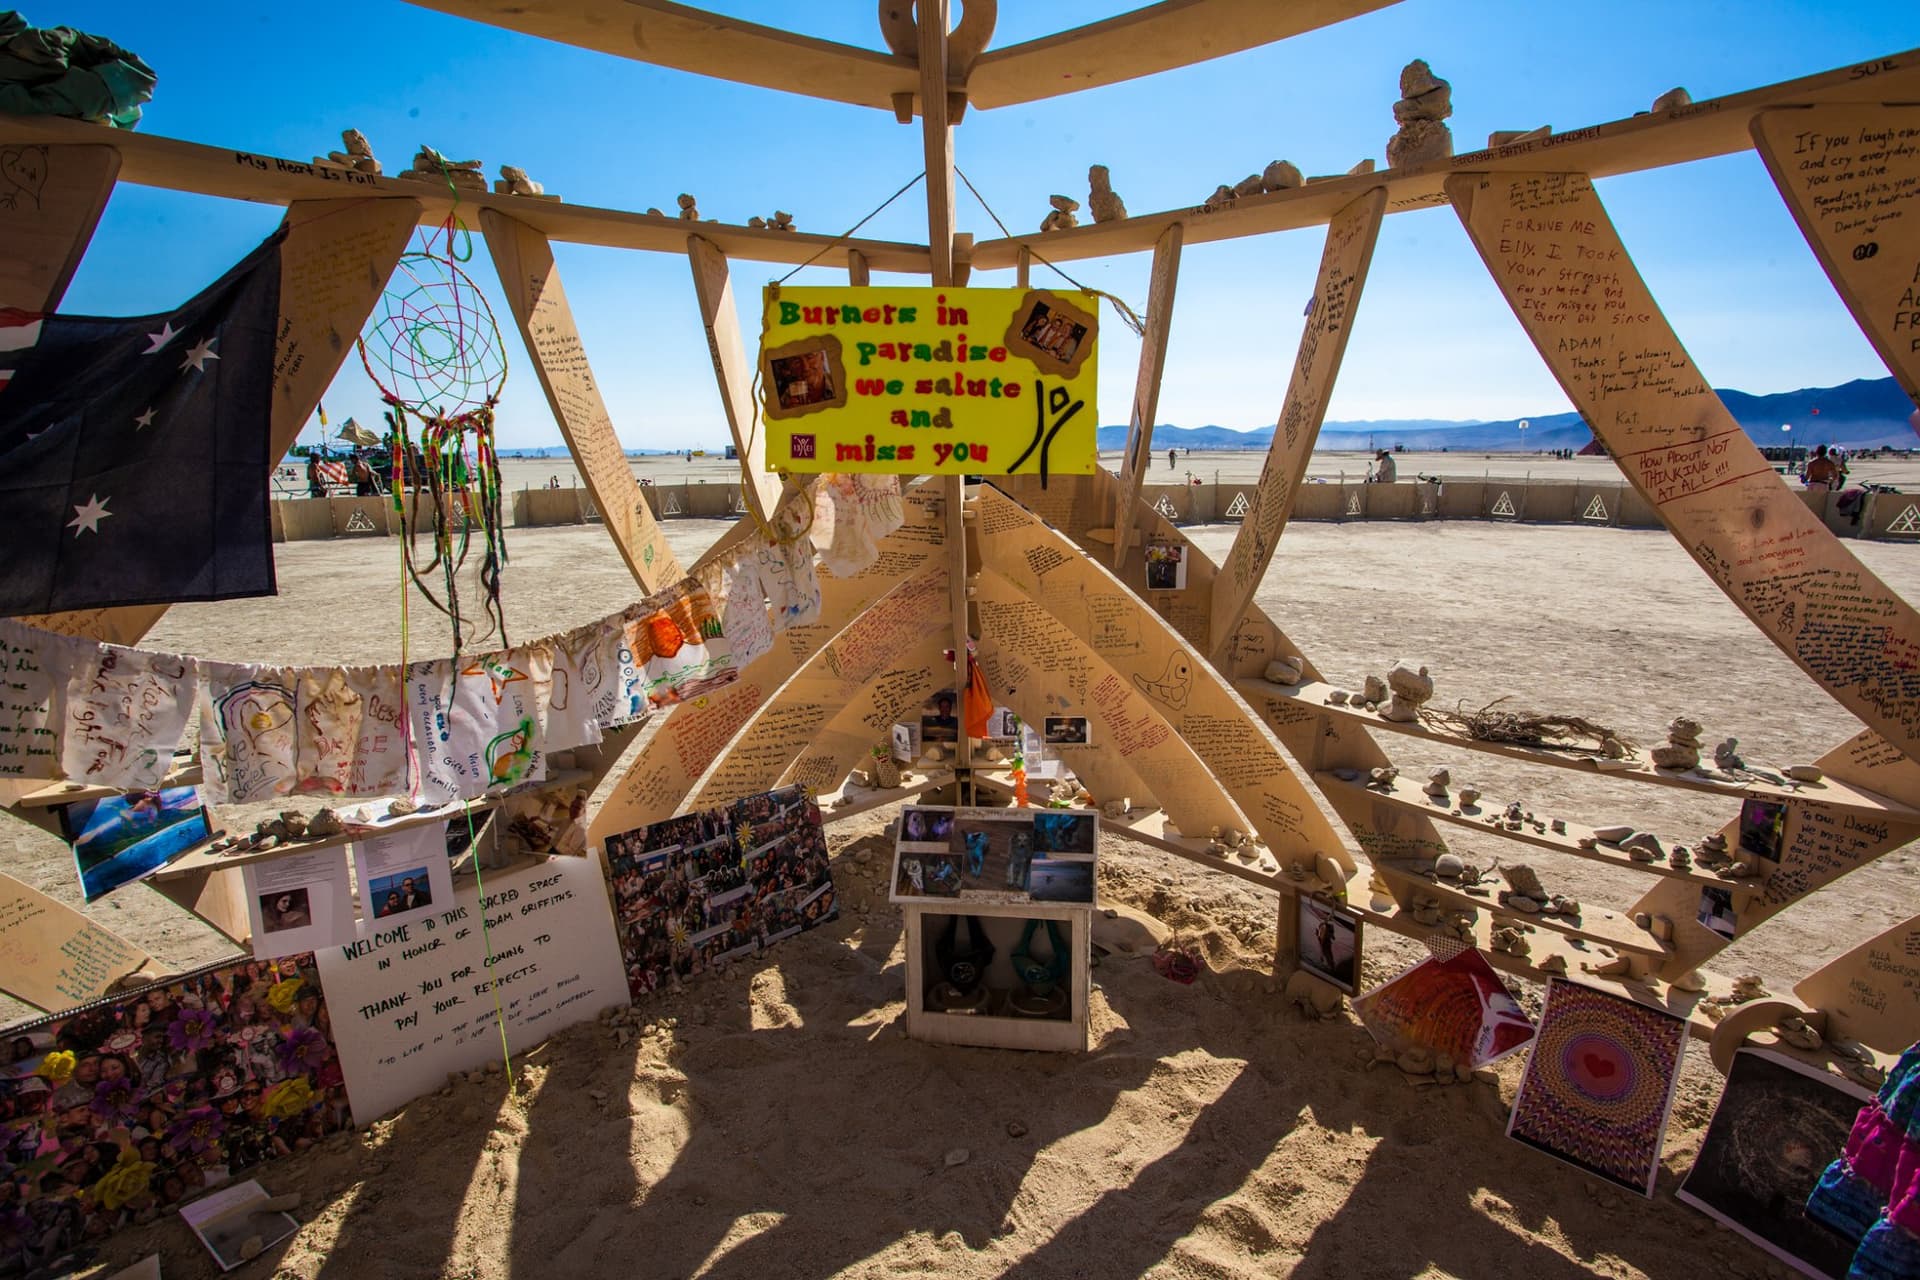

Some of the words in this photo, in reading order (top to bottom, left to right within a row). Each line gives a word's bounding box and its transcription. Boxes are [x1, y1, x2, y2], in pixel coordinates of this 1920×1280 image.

[1794, 130, 1821, 154] If
[1825, 135, 1850, 152] you
[1859, 127, 1895, 149] laugh
[236, 151, 268, 170] My
[276, 158, 314, 176] Heart
[320, 166, 340, 180] Is
[346, 171, 376, 185] Full
[1800, 155, 1826, 170] and
[1830, 157, 1852, 171] cry
[1806, 175, 1830, 190] you
[1570, 220, 1596, 235] ME
[1546, 243, 1562, 260] I
[779, 301, 917, 326] Burners
[937, 294, 969, 326] in
[1558, 338, 1602, 352] ADAM
[1571, 357, 1606, 369] Thanks
[855, 377, 904, 396] we
[914, 372, 1021, 399] salute
[890, 406, 954, 429] and
[835, 435, 915, 462] miss
[933, 442, 988, 466] you
[1640, 455, 1664, 469] HOW
[1667, 449, 1702, 464] ABOUT
[1706, 438, 1731, 455] NOT
[1641, 459, 1711, 489] THINKING
[1658, 486, 1674, 500] AT
[1681, 475, 1714, 493] ALL
[469, 752, 480, 778] Vision
[427, 770, 458, 798] Family
[1850, 838, 1869, 851] you
[342, 925, 410, 961] WELCOME
[423, 918, 437, 932] TO
[441, 906, 469, 928] THIS
[479, 888, 520, 912] SACRED
[529, 873, 563, 893] SPACE
[378, 957, 391, 971] IN
[403, 937, 446, 961] HONOR
[455, 928, 472, 941] OF
[484, 912, 514, 930] ADAM
[358, 990, 412, 1022] THANK
[417, 978, 443, 996] YOU
[451, 965, 476, 984] FOR
[483, 944, 525, 969] COMING
[534, 932, 552, 945] TO
[394, 1011, 419, 1031] PAY
[432, 994, 465, 1015] YOUR
[402, 1042, 425, 1058] LIVE
[433, 1033, 443, 1045] IN
[450, 1022, 469, 1034] THE
